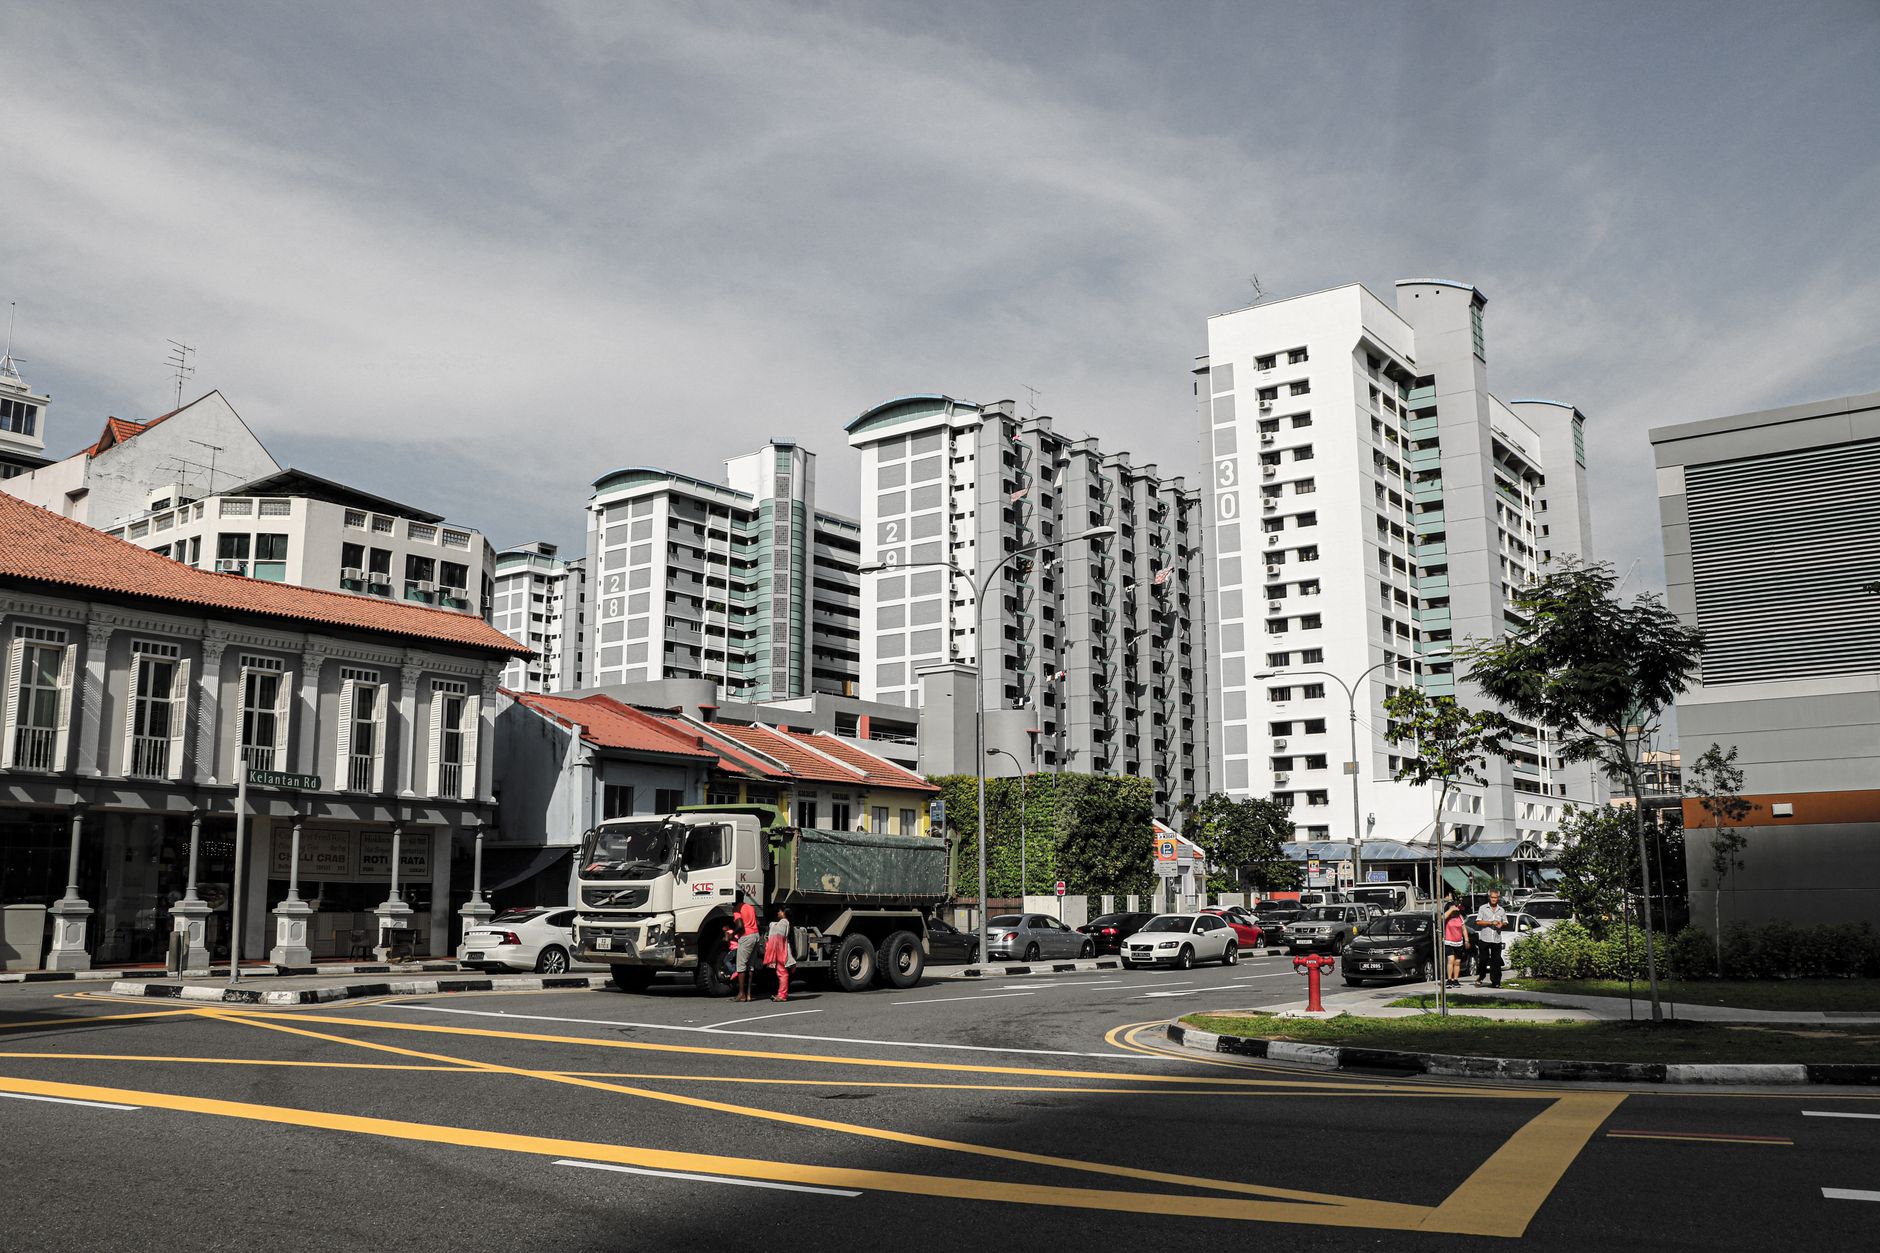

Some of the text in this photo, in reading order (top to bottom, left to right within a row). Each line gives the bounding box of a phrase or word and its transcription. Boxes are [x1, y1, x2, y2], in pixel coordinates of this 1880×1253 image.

[249, 770, 317, 789] Kelantan Rd
[317, 853, 345, 862] CRAB
[363, 855, 425, 865] ROTI RATA
